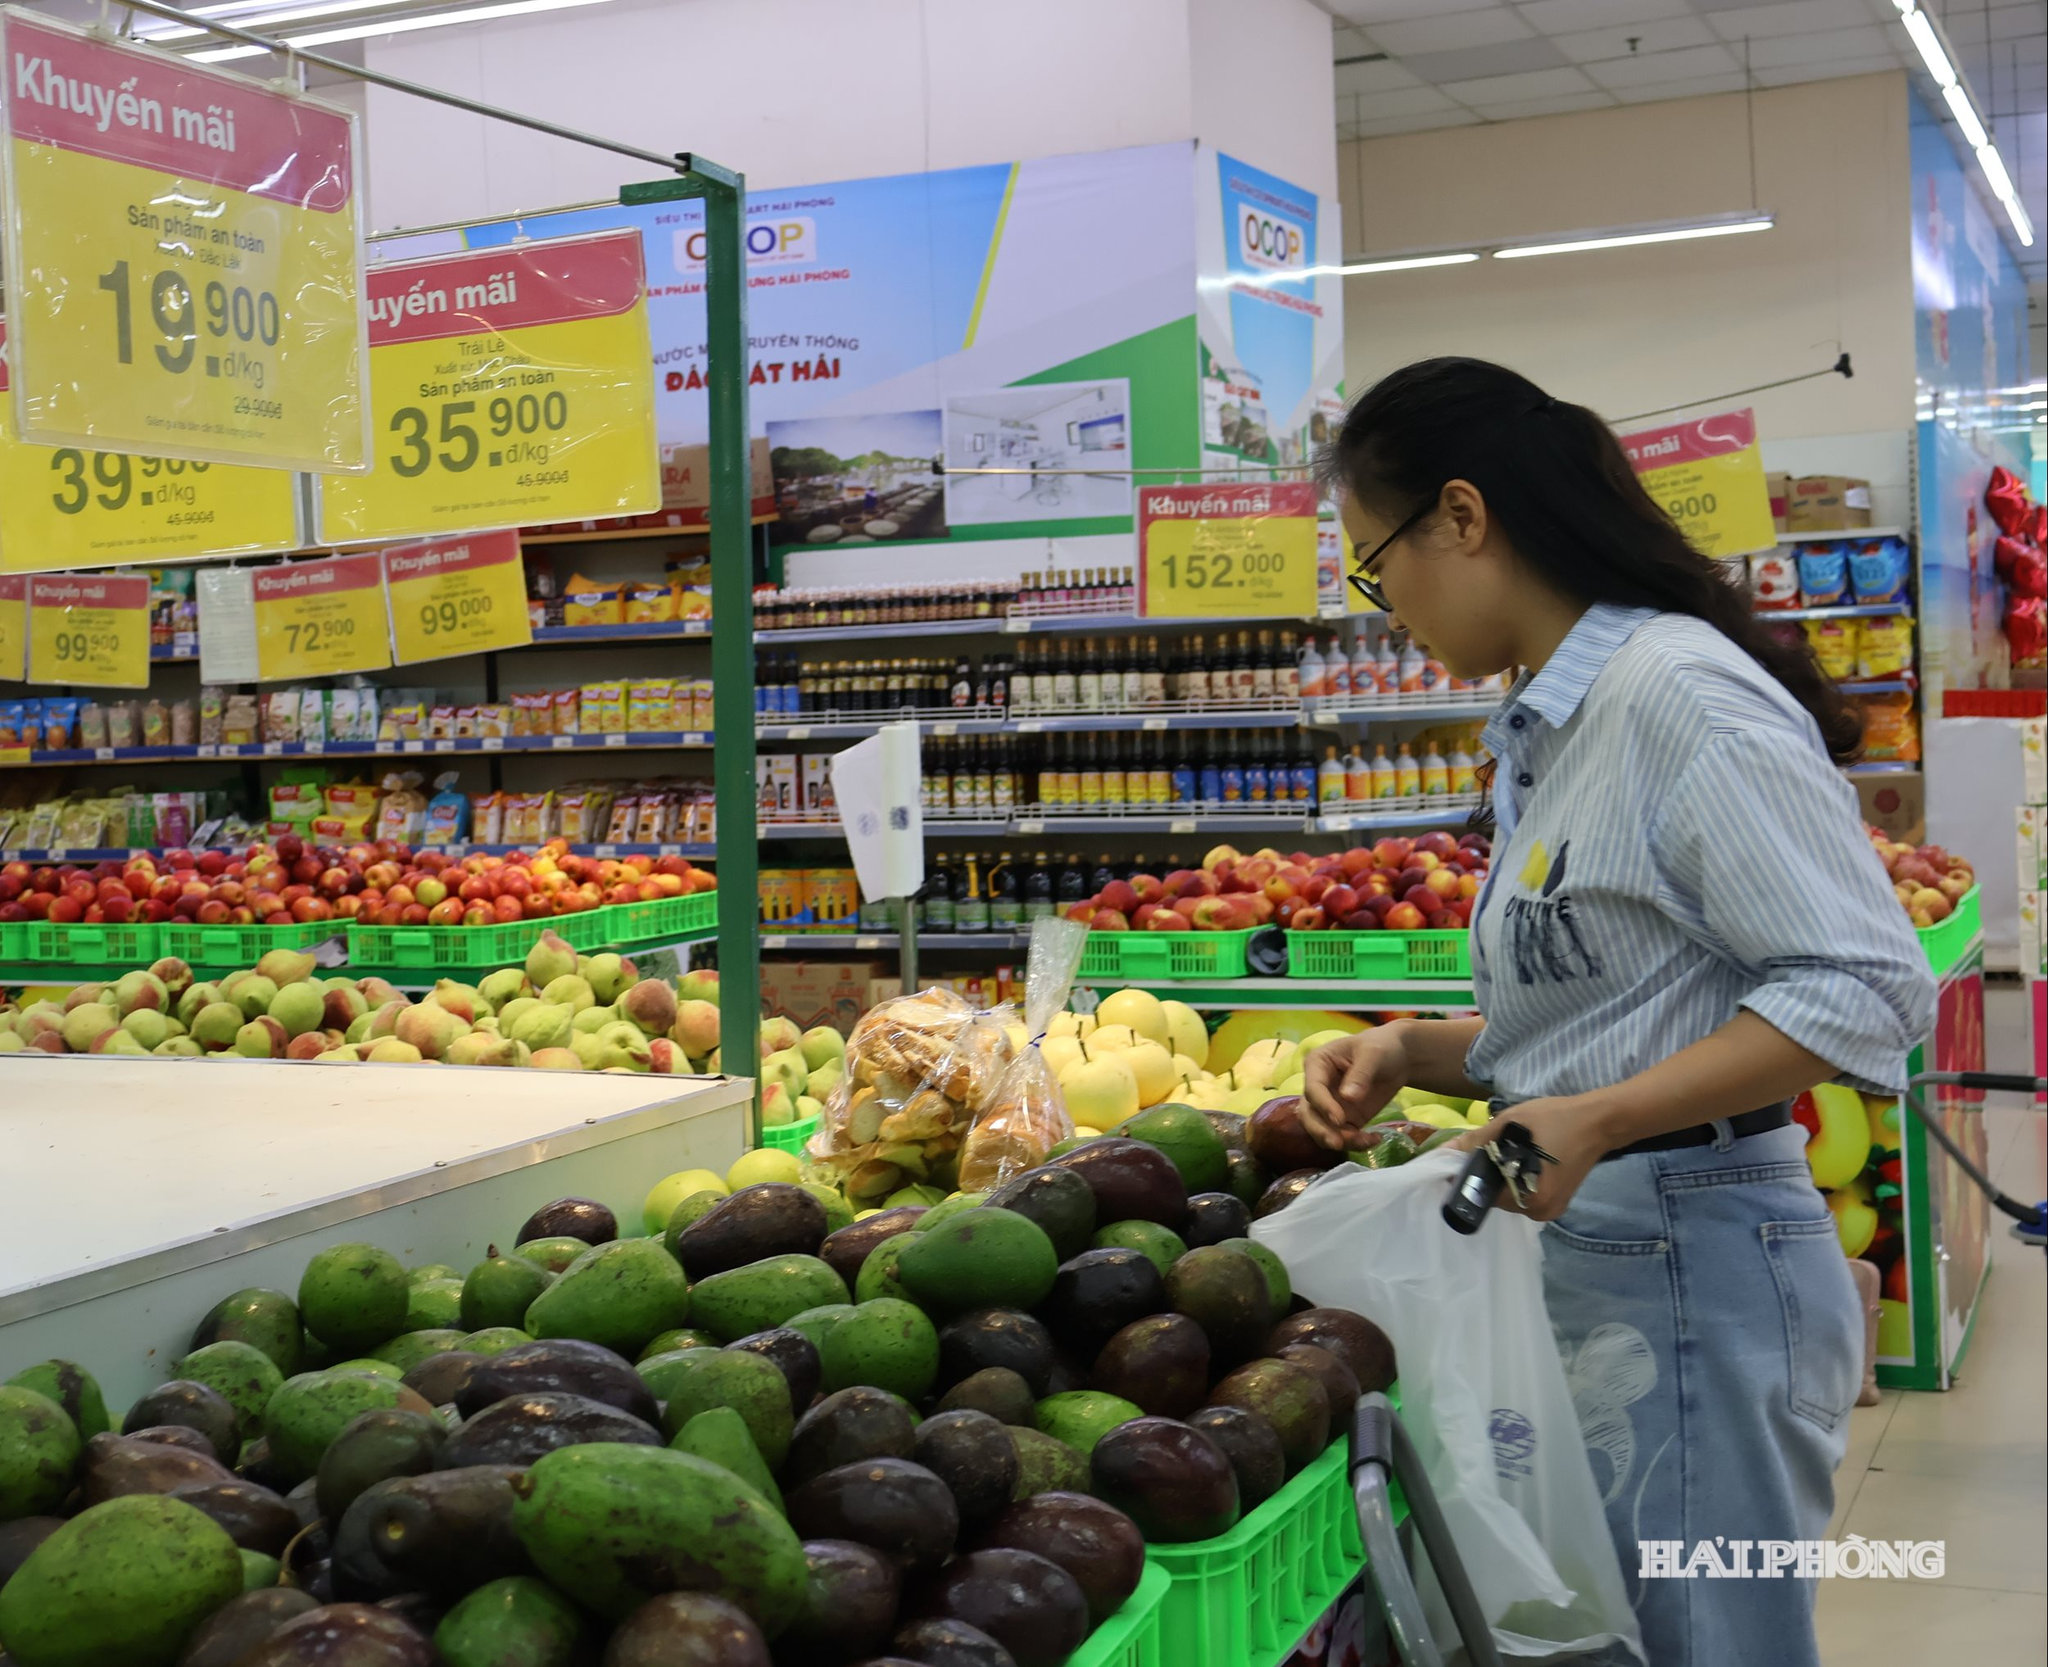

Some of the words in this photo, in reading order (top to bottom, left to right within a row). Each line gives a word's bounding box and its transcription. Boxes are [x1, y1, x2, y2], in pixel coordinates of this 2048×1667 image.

[15, 53, 163, 133] Khuyến
[173, 105, 236, 152] mãi
[747, 204, 769, 215] ART
[212, 229, 230, 246] an
[1245, 213, 1300, 264] OCOP
[367, 281, 448, 328] uyến
[456, 272, 517, 310] mãi
[748, 360, 785, 386] ÁT
[420, 381, 448, 398] Sản
[497, 377, 517, 390] an
[1642, 435, 1681, 458] mãi
[1148, 493, 1228, 518] Khuyến
[1233, 493, 1271, 512] mãi
